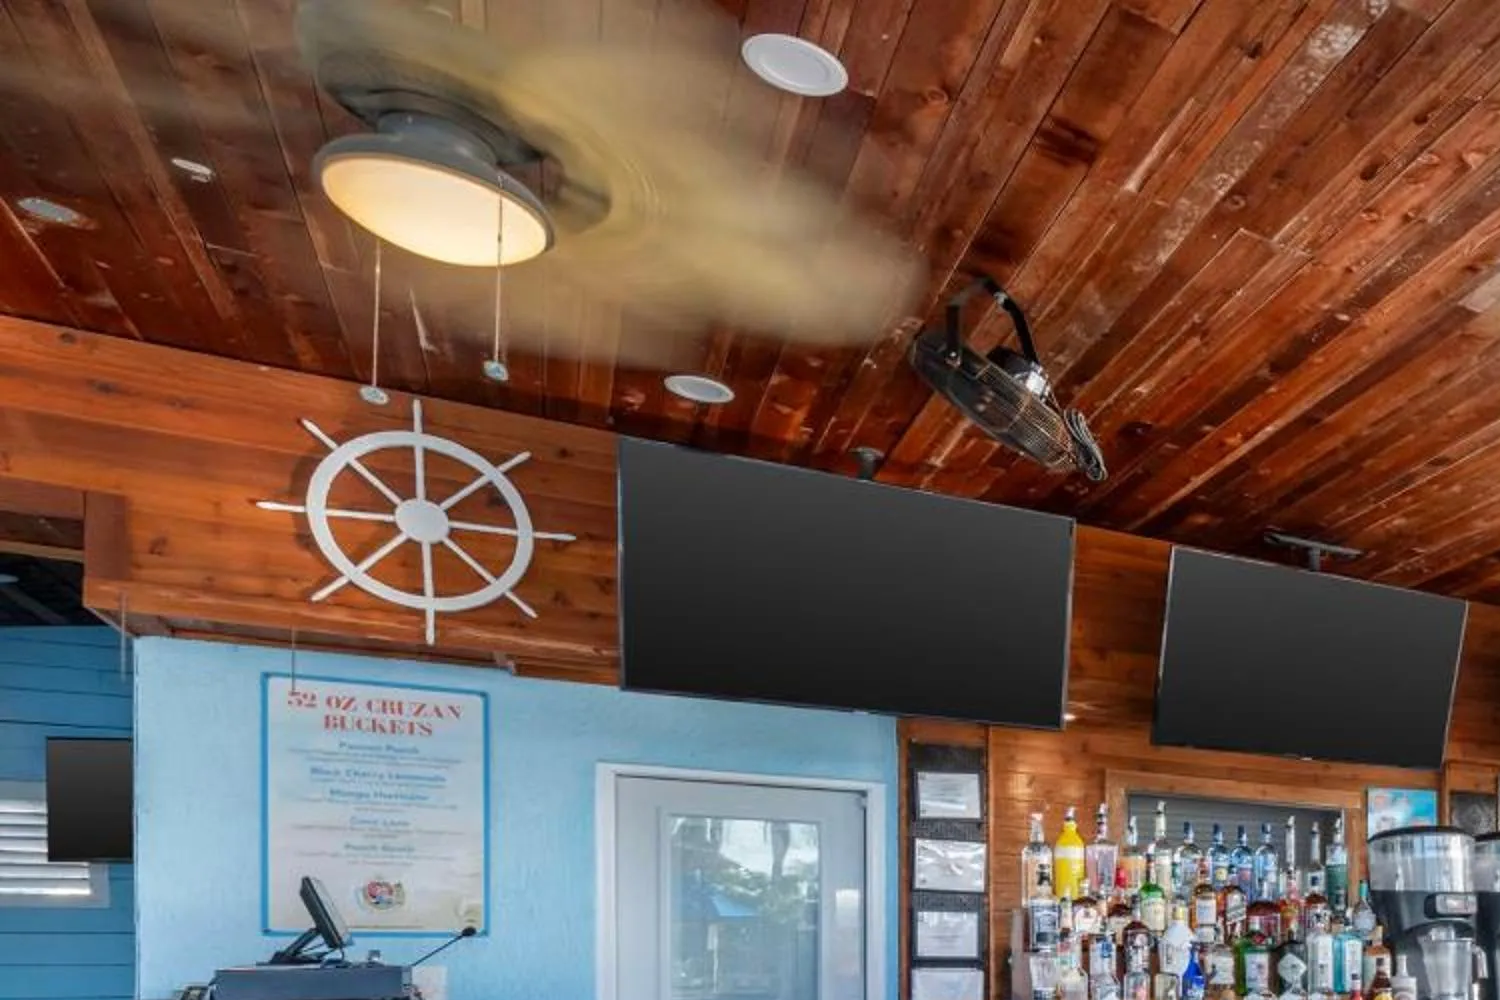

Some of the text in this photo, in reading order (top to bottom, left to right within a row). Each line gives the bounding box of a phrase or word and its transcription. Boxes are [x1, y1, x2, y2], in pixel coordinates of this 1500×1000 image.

[288, 691, 463, 720] 52 OZ CRUZAN
[324, 714, 433, 737] BUCKETS
